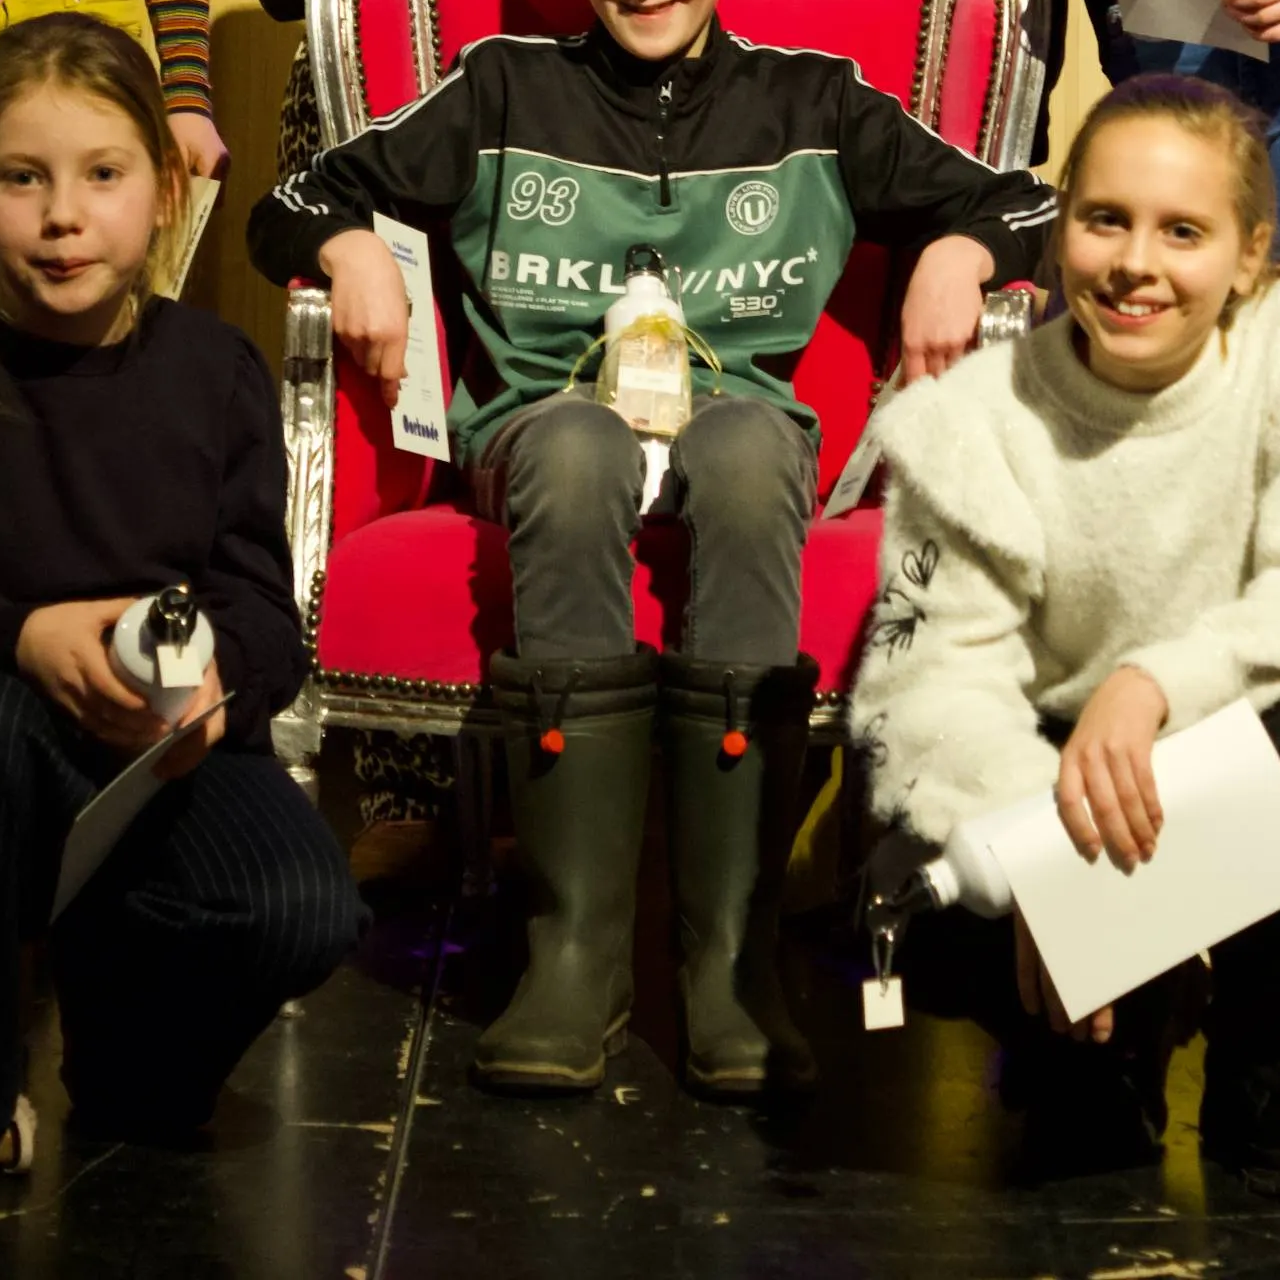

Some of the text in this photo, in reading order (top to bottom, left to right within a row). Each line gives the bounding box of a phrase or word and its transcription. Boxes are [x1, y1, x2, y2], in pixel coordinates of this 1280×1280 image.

[507, 171, 580, 226] 93
[743, 199, 766, 226] U
[730, 295, 777, 311] 530
